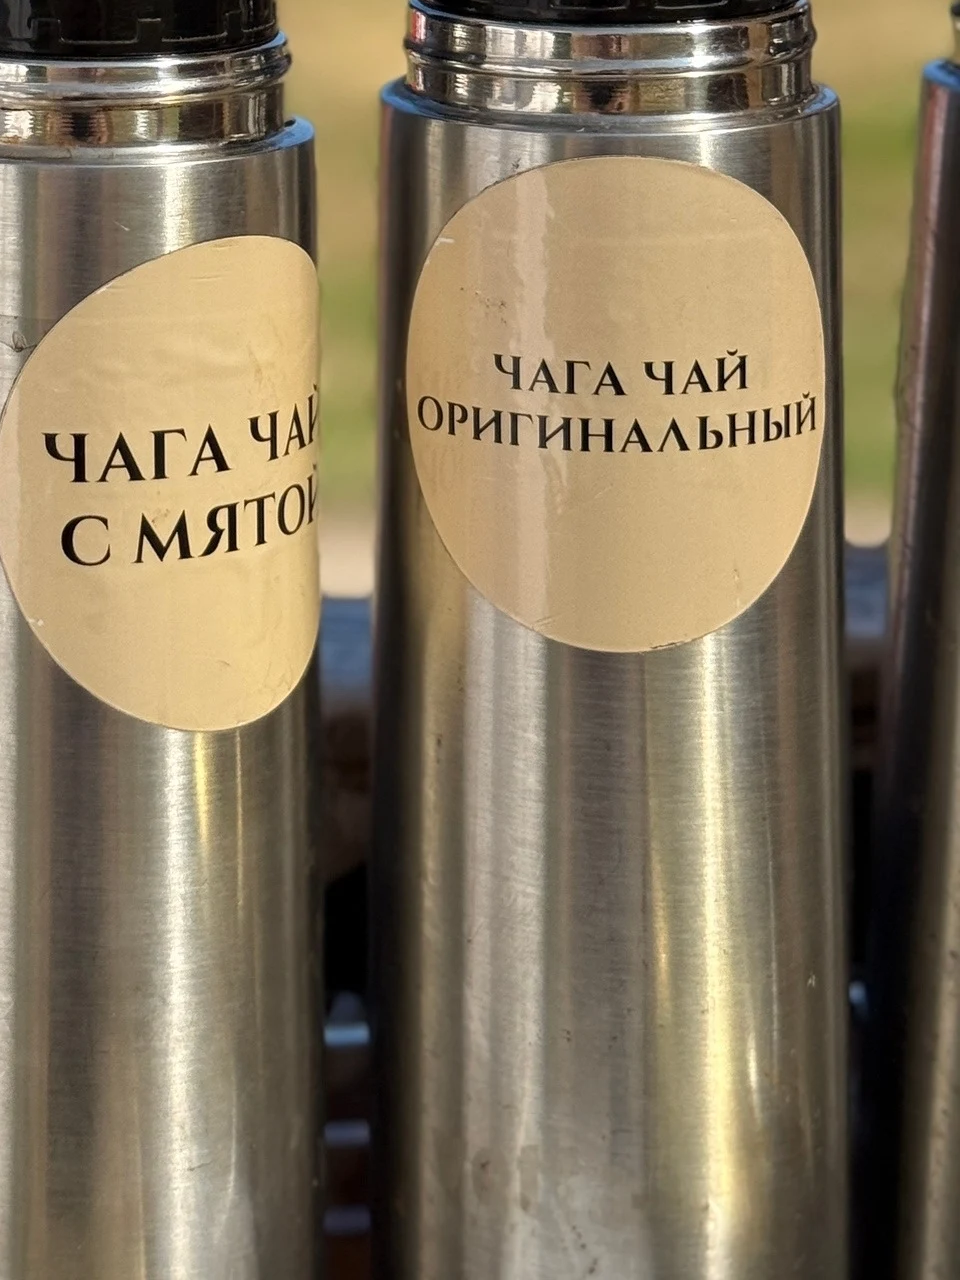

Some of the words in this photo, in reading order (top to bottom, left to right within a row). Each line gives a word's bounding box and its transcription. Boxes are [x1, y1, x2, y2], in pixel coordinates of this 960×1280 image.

[493, 353, 627, 396] ЧАГА
[643, 349, 749, 396] ЧАЙ
[416, 390, 818, 453] ОРИГИНАЛЬНЫЙ
[42, 423, 232, 483] ЧАГА
[60, 514, 112, 567] С
